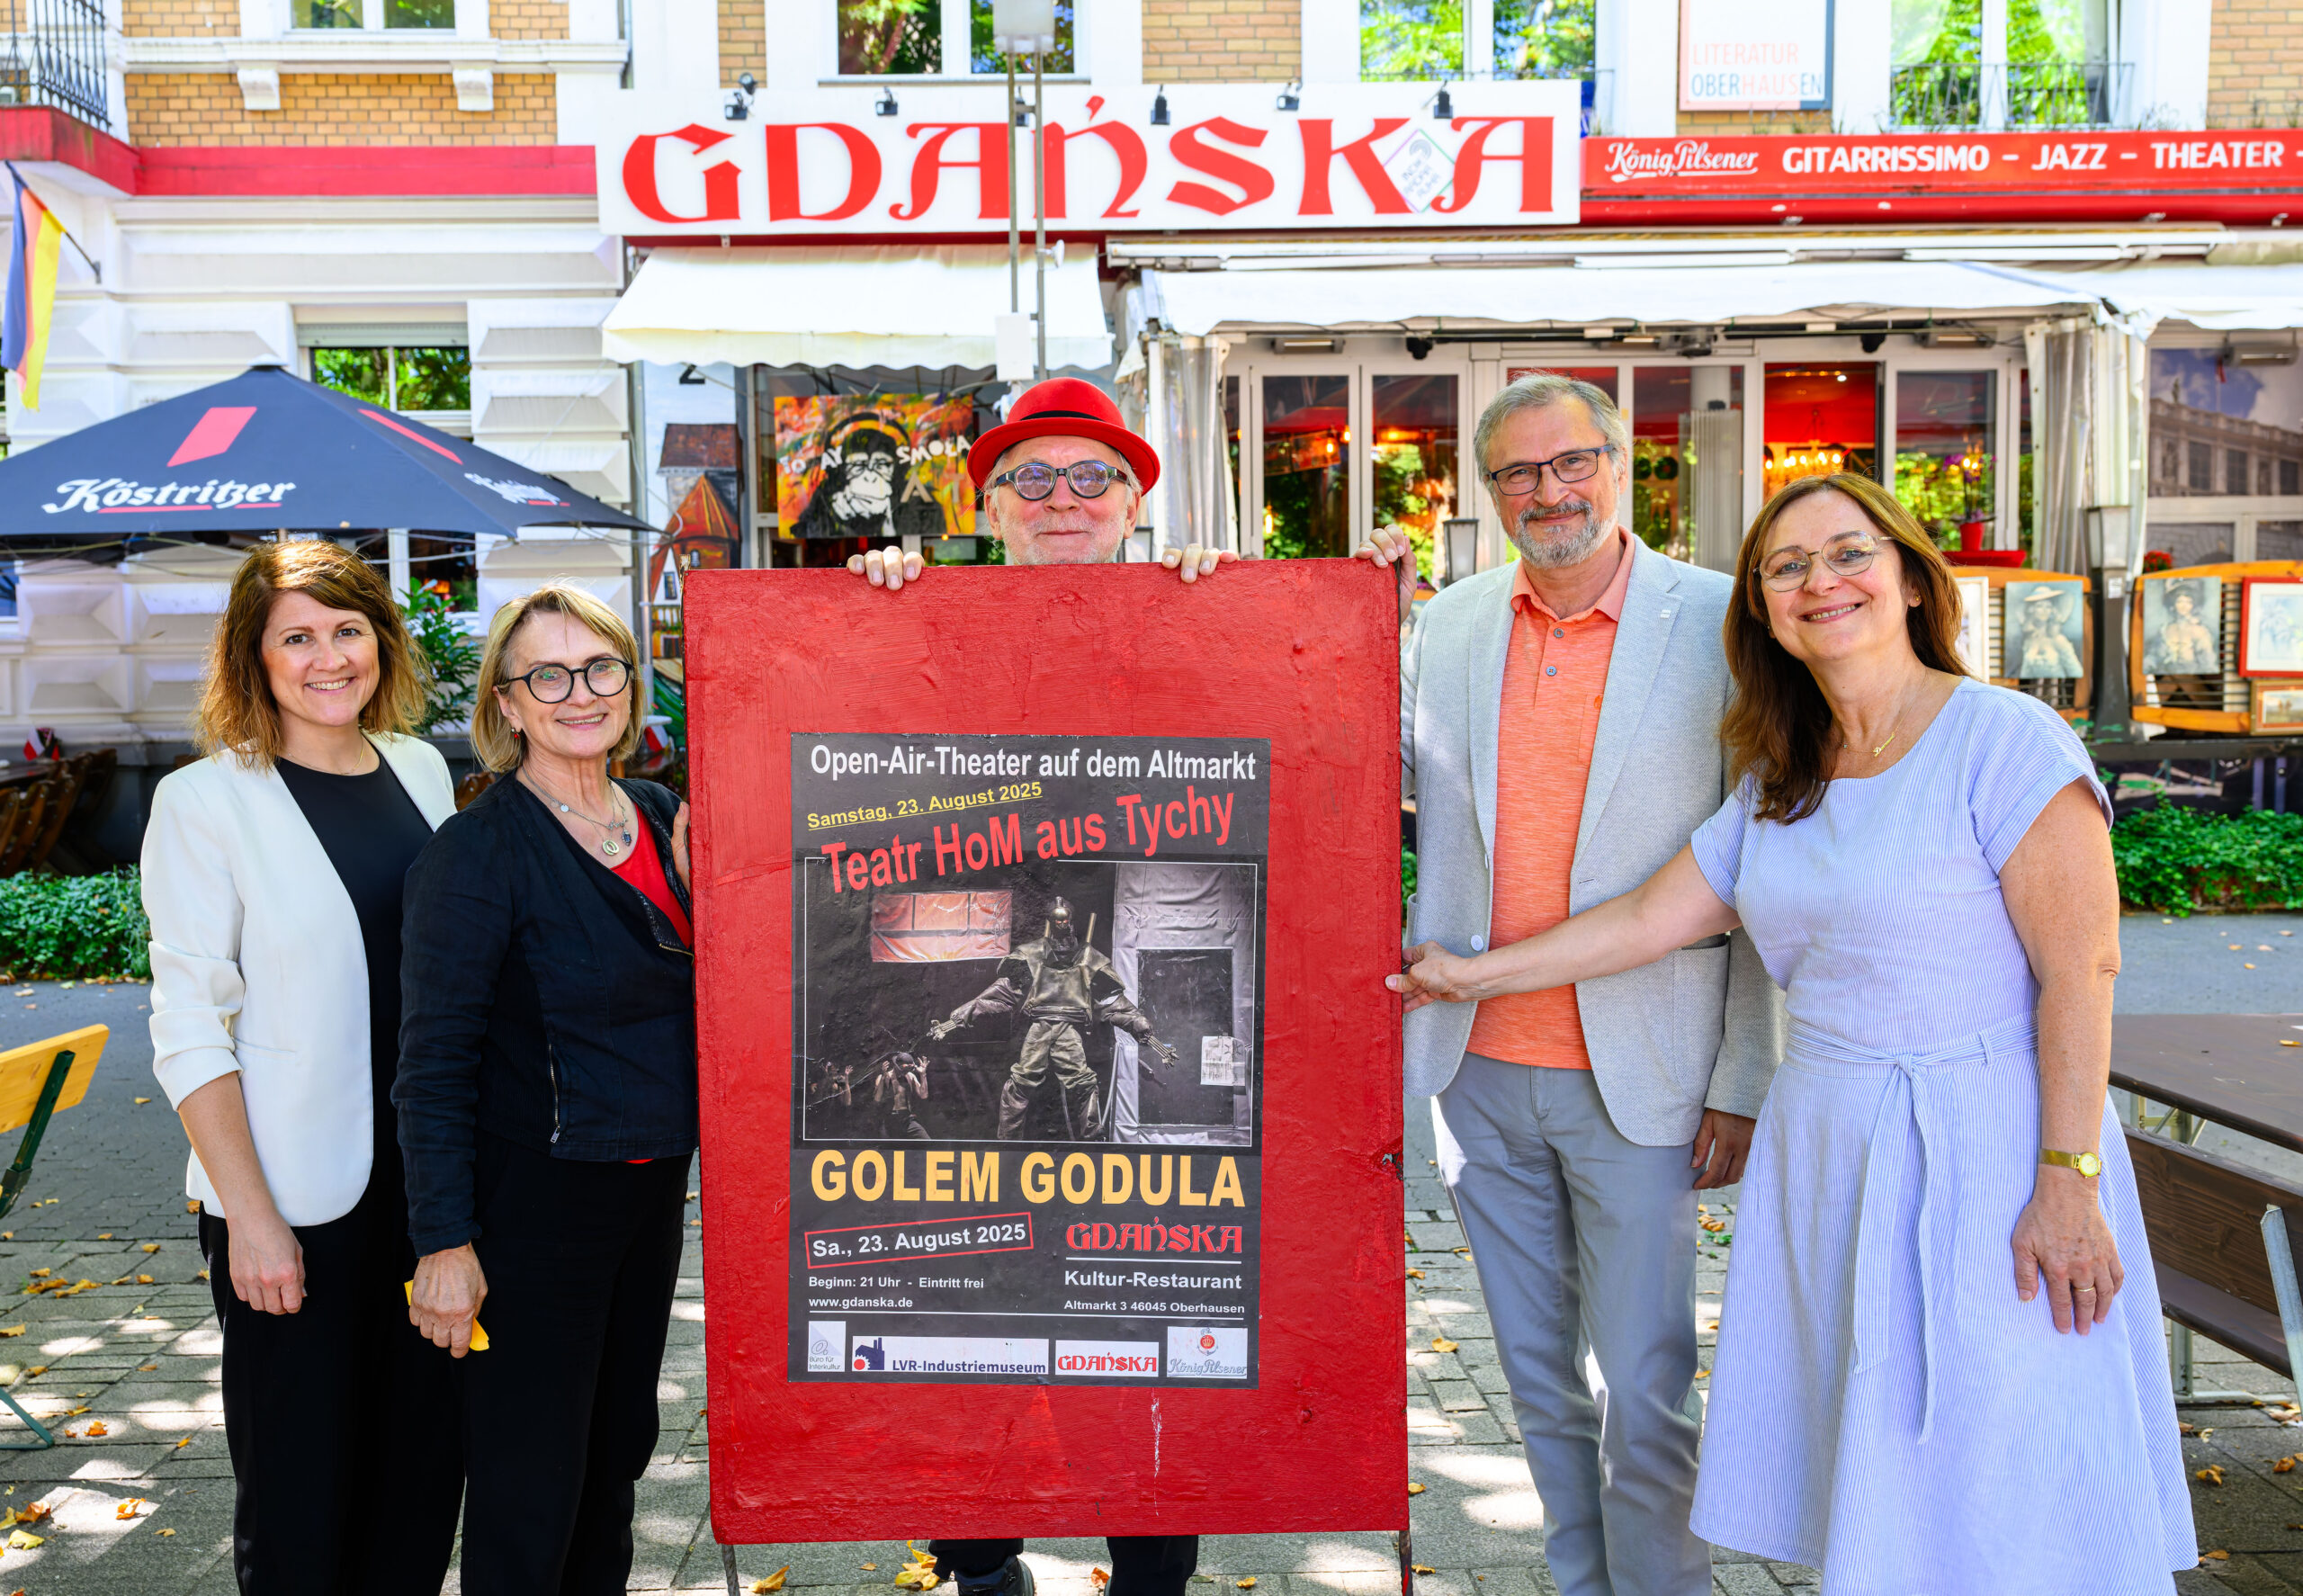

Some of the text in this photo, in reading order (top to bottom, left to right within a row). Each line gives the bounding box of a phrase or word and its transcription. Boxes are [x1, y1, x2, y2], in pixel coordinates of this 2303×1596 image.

[1692, 43, 1799, 66] LITERATUR
[1691, 73, 1823, 97] OBERHAUSEN
[623, 97, 1553, 222] GDAŃSKA
[1605, 139, 1760, 177] König Pilsener
[1783, 145, 1989, 173] GITARRISSIMO
[2031, 144, 2107, 170] JAZZ
[2151, 142, 2284, 168] THEATER
[811, 745, 1256, 781] Open-Air-Theater auf dem Altmarkt
[808, 782, 1042, 826] Samstag, 23. August 2025
[821, 785, 1233, 898] Teatr HoM aus Tychy
[811, 1150, 1245, 1206] GOLEM GODULA
[813, 1224, 1026, 1257] Sa., 23. August 2025
[1066, 1217, 1241, 1252] GDAŃSKA
[809, 1276, 856, 1290] Beginn:
[860, 1277, 873, 1287] 21
[879, 1278, 901, 1287] Uhr
[919, 1278, 960, 1287] Eintritt
[964, 1278, 983, 1287] frei
[1065, 1271, 1241, 1288] Kultur-Restaurant
[809, 1297, 912, 1309] www.gdanska.de
[1064, 1301, 1244, 1313] Altmarkt 3 46045 Oberhausen
[893, 1360, 1045, 1373] LVR-Industriemuseum
[1058, 1352, 1156, 1371] GDAŃSKA
[1168, 1358, 1204, 1376] König
